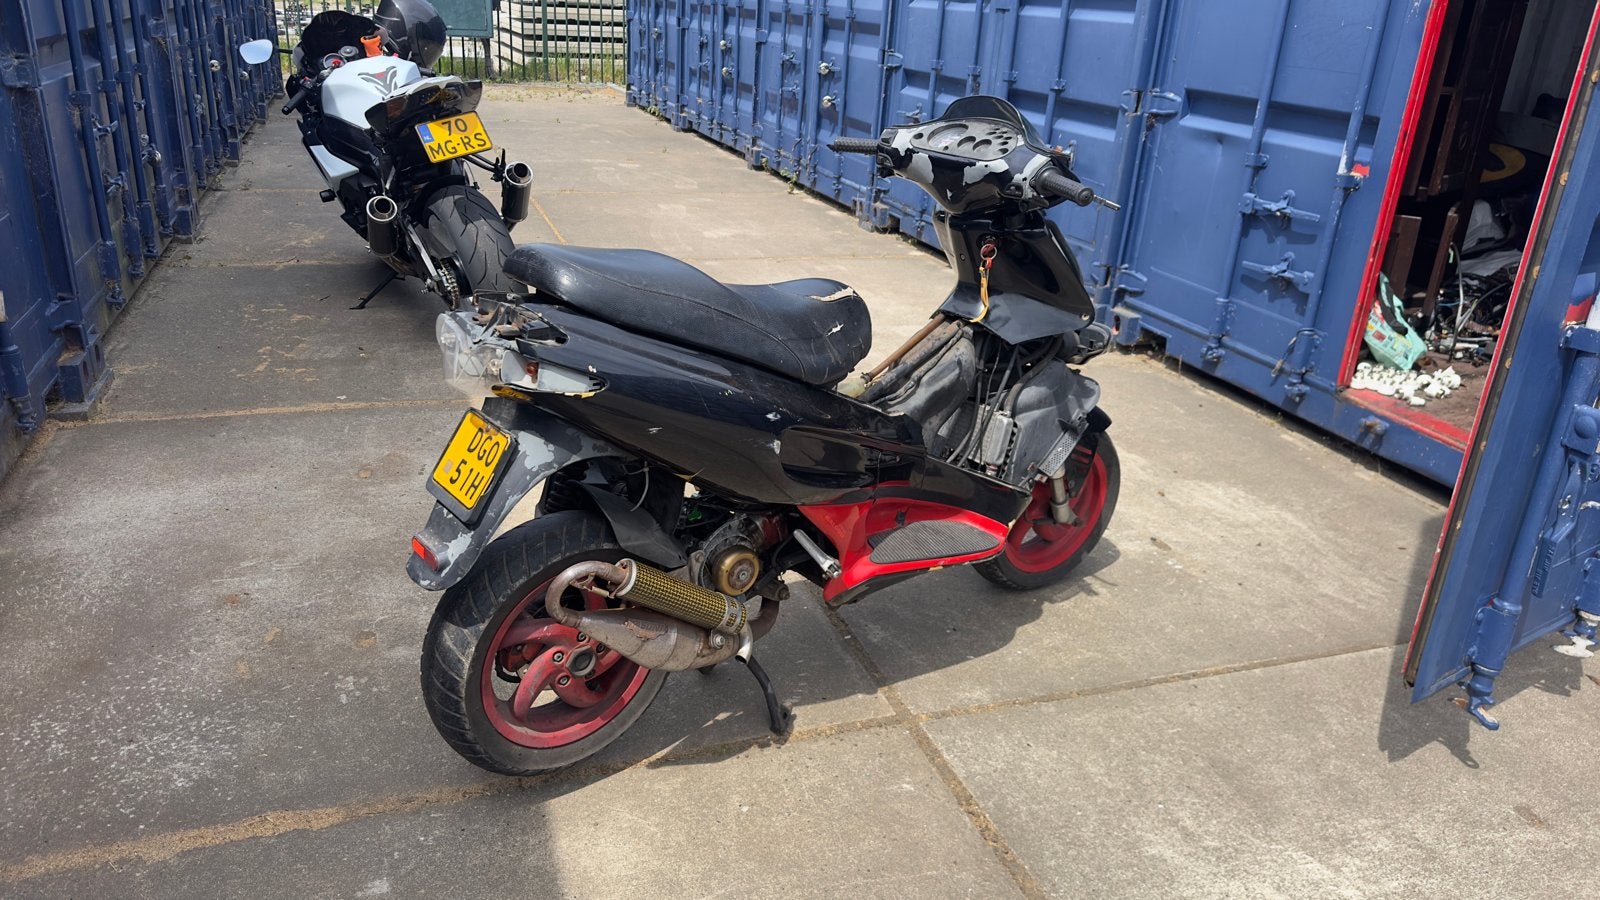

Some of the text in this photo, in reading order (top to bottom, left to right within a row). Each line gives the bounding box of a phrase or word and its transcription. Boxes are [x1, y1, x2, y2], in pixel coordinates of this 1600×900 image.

[441, 118, 468, 136] 70
[428, 132, 487, 160] MG-RS
[449, 458, 485, 500] 51H
